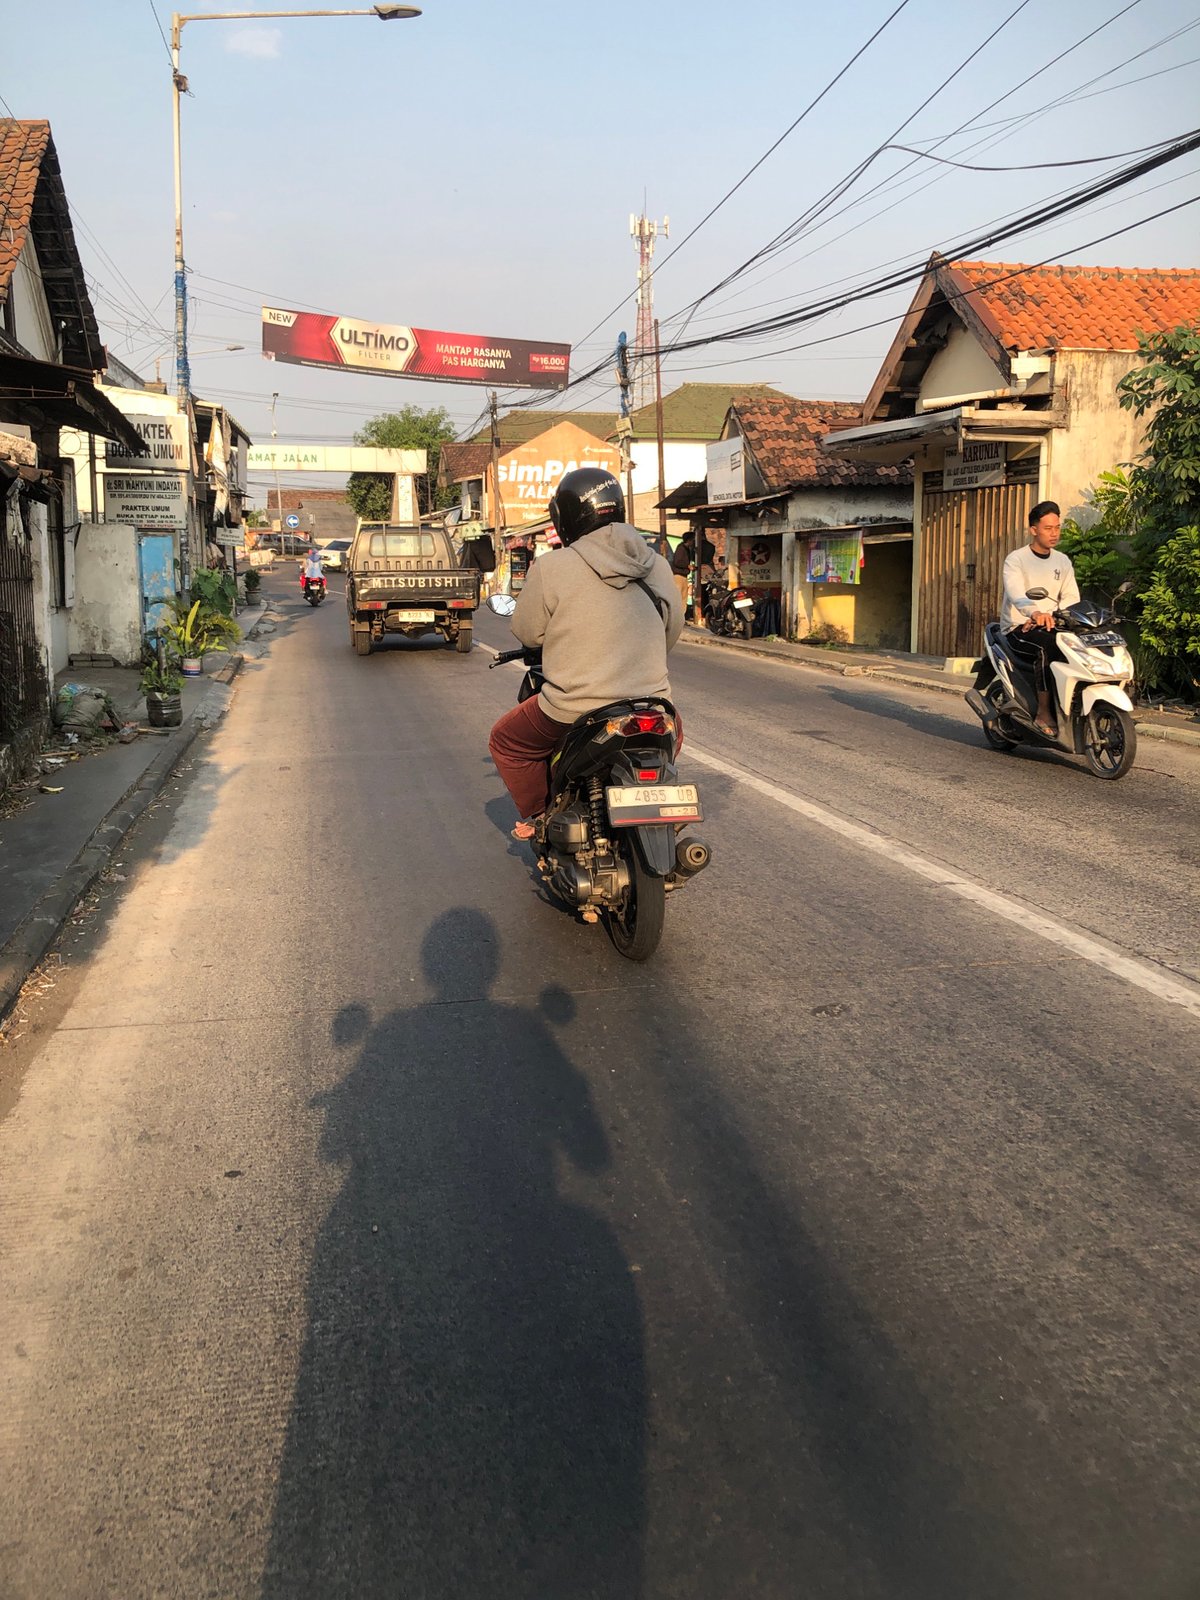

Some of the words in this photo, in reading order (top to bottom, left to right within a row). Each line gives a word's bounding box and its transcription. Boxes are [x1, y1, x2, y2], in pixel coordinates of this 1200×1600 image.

[268, 311, 292, 324] NEW
[358, 350, 391, 361] FILTER
[436, 343, 471, 356] MANTAP
[473, 347, 512, 359] RASANYA
[442, 355, 459, 366] PAS
[460, 357, 506, 370] HARGANYA
[134, 422, 173, 440] AKTEK
[153, 443, 183, 460] UMUM
[283, 453, 318, 463] JALAN
[114, 480, 124, 490] SRI
[126, 480, 155, 491] WAHYUNI
[156, 481, 183, 492] INDAYATI
[121, 504, 150, 512] PRAKTEK
[372, 576, 460, 588] MITSUBISHI
[612, 790, 622, 803] W
[634, 789, 667, 803] 4855
[677, 789, 694, 801] UB
